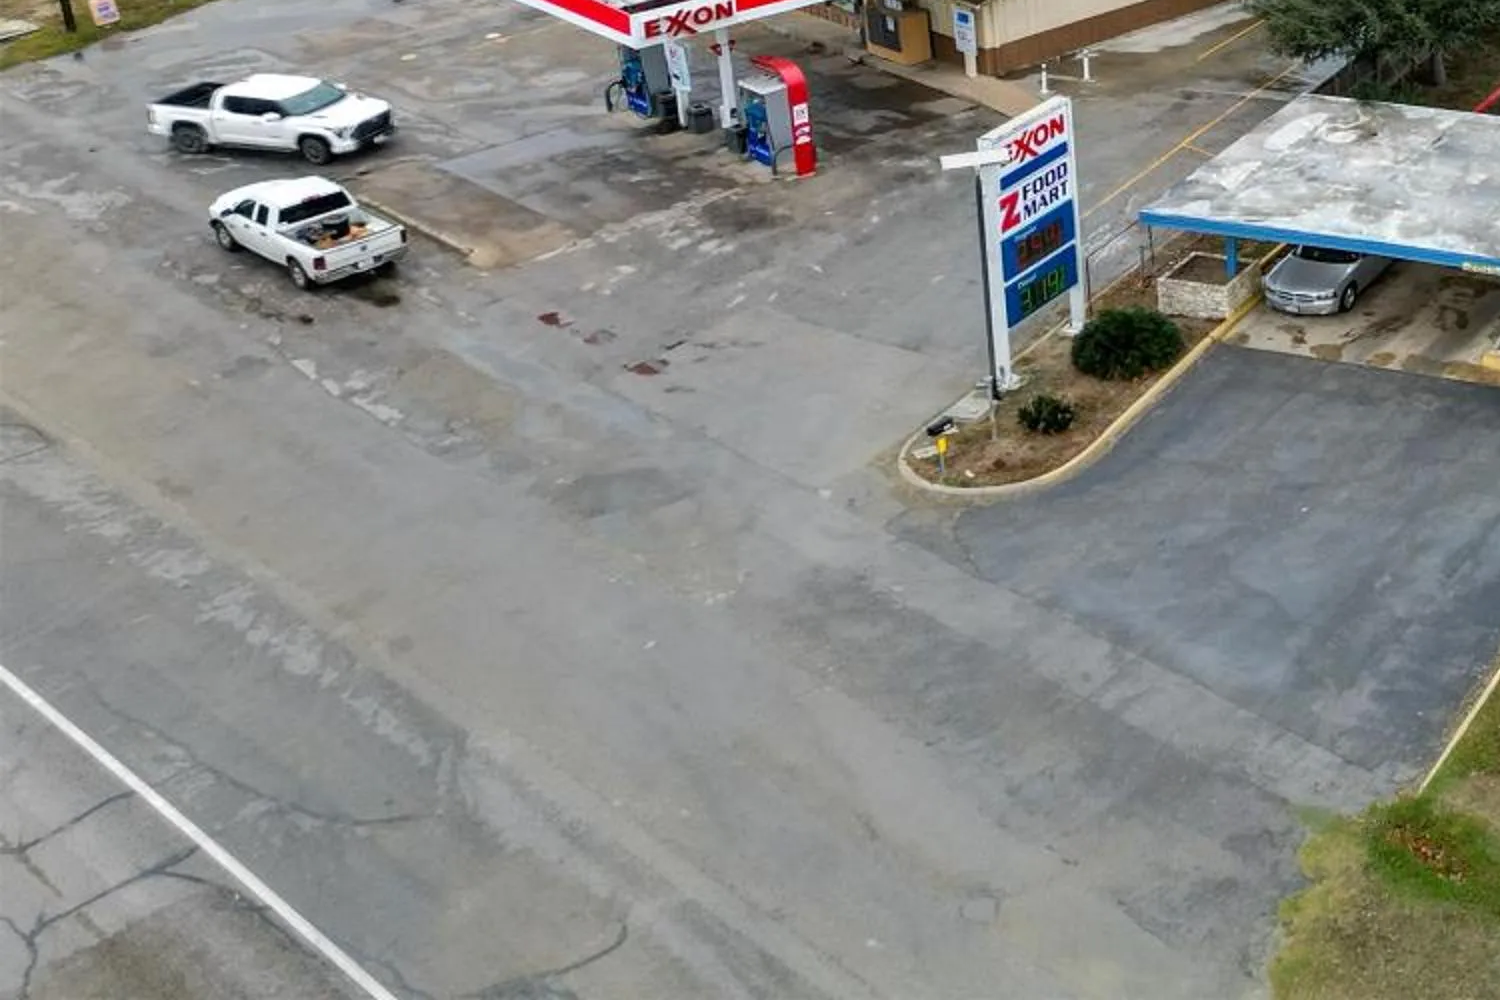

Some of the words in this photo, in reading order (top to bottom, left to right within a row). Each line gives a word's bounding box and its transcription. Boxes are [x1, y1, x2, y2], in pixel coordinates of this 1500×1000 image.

[643, 1, 734, 38] EXXON
[1022, 161, 1067, 200] FOOD
[1023, 180, 1068, 220] MART
[999, 190, 1021, 233] Z
